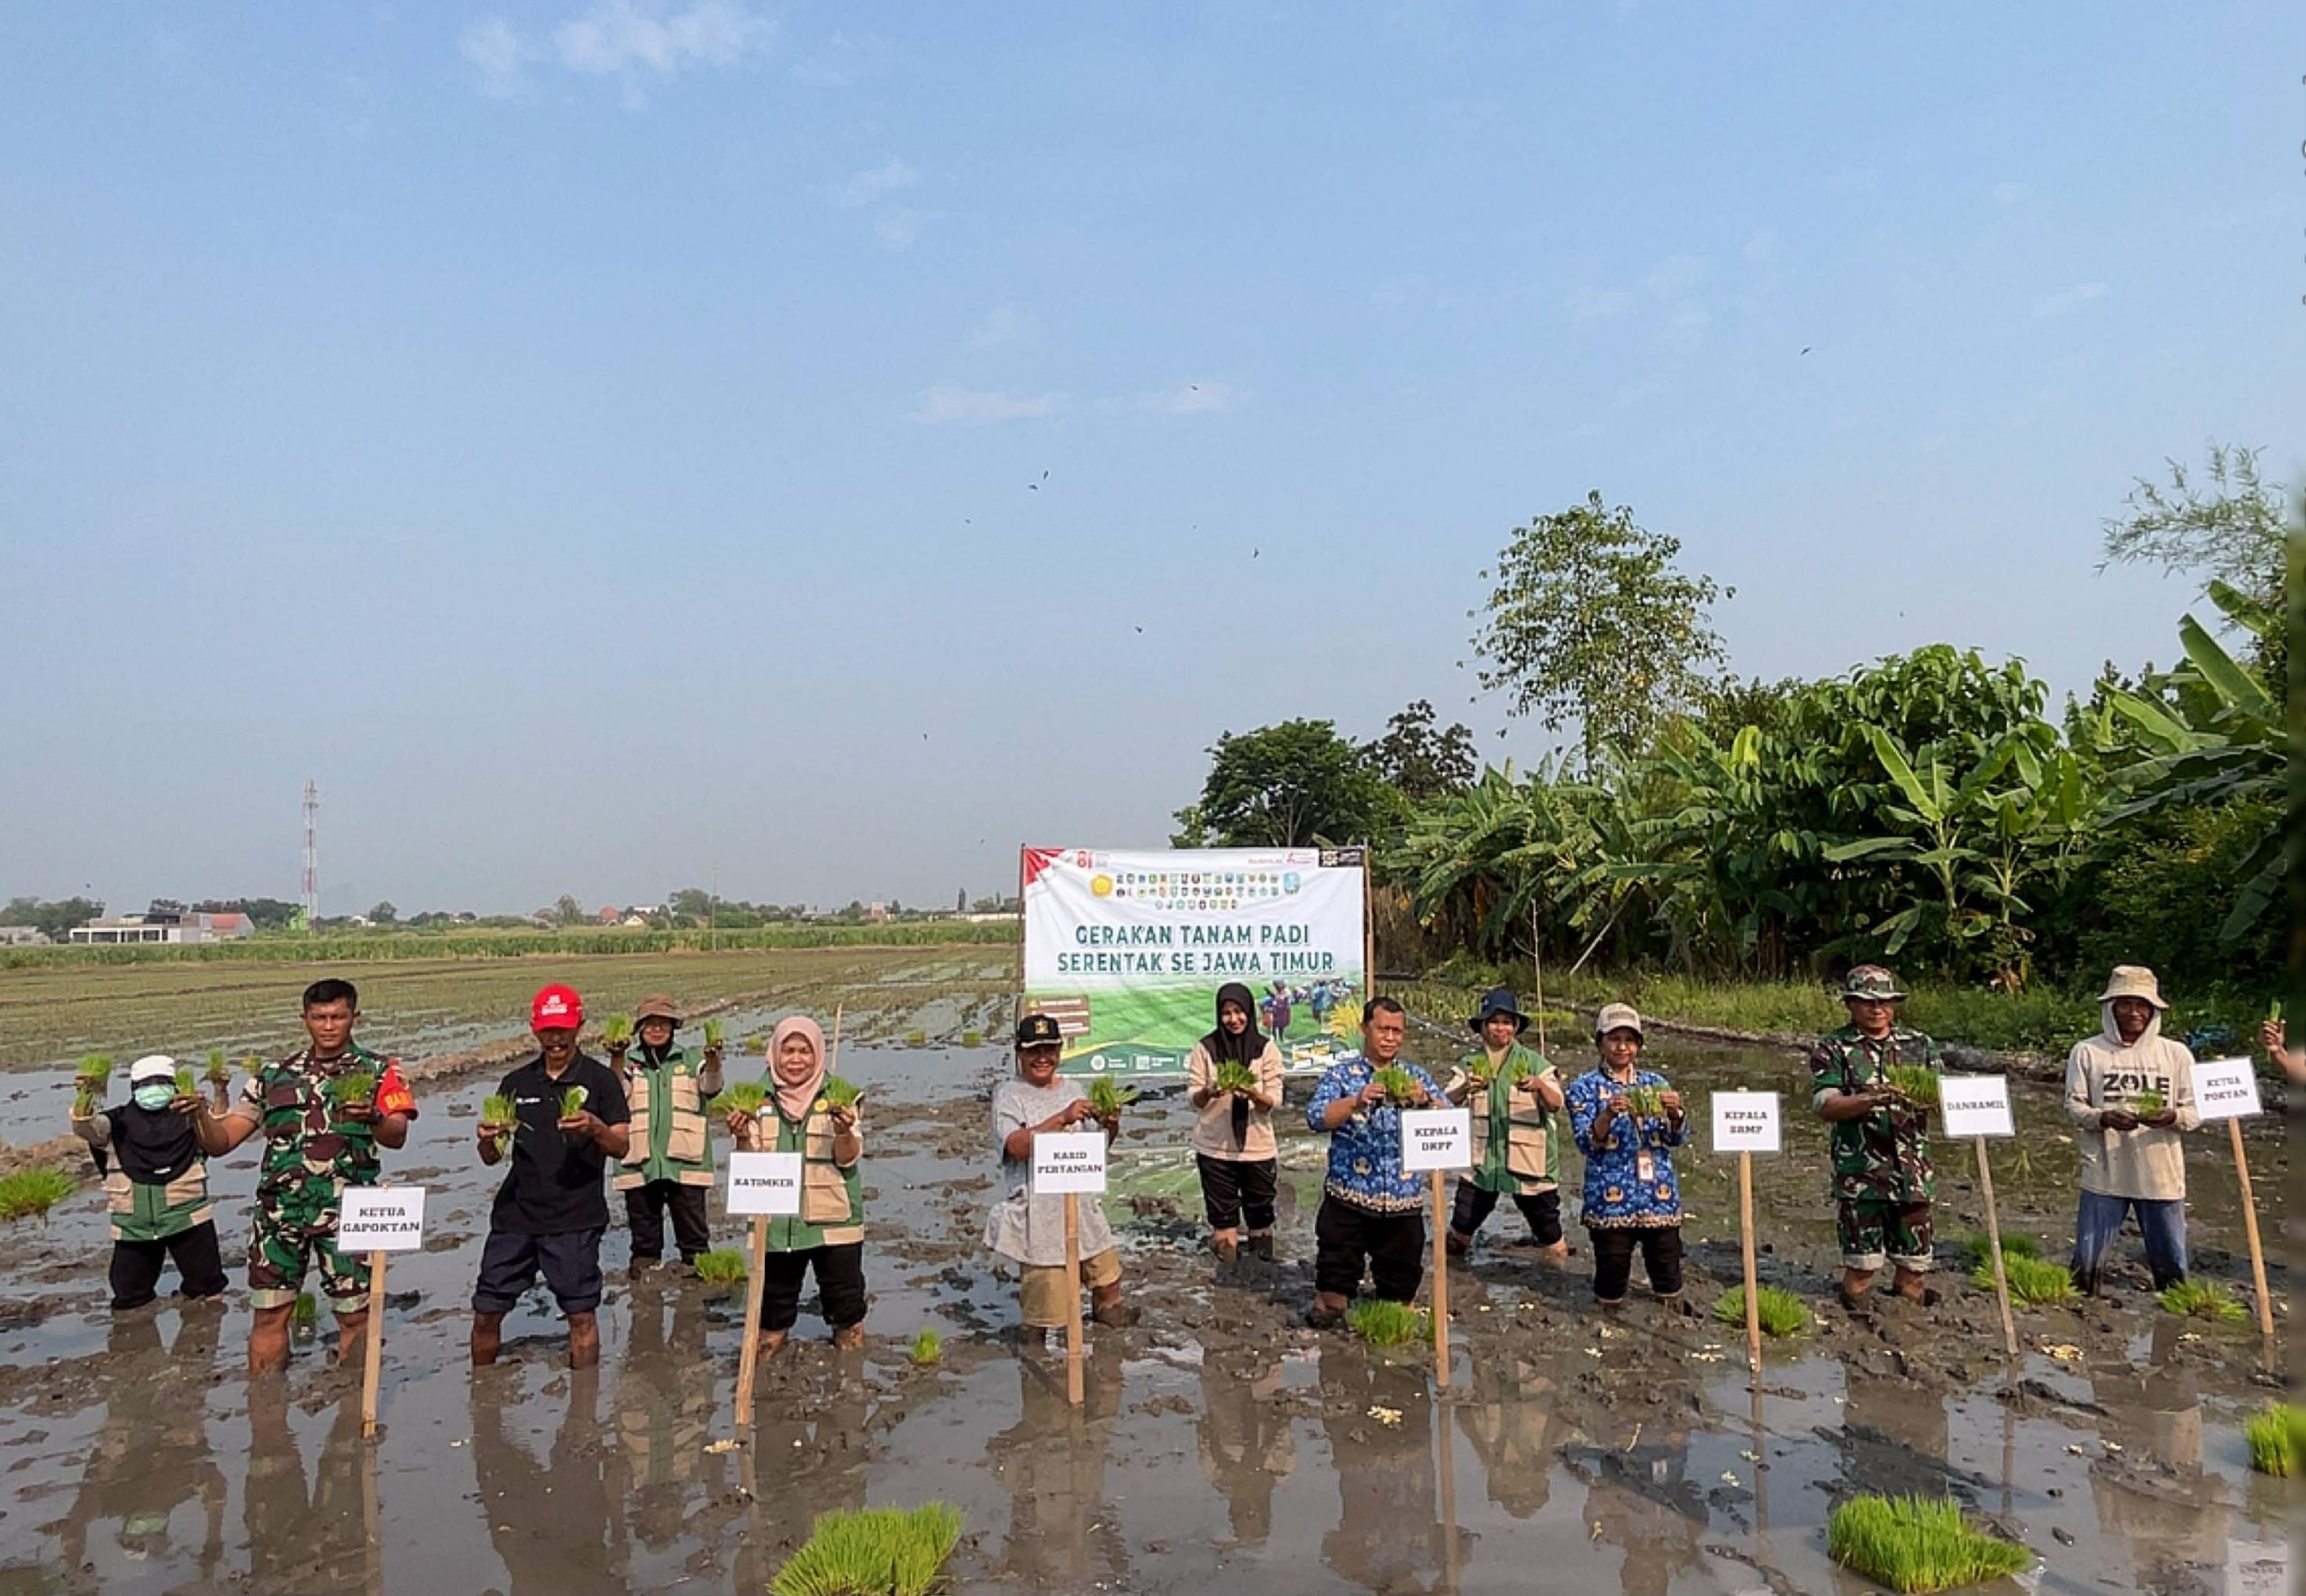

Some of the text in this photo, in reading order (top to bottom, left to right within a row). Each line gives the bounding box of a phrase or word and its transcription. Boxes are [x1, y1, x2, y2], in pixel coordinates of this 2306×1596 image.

[1076, 925, 1309, 944] GERAKAN TANAM PADI
[1058, 951, 1334, 972] SERENTAK SE JAWA TIMUR
[2206, 1075, 2241, 1087] KETUA
[2204, 1089, 2248, 1102] POKTAN
[1947, 1101, 2005, 1111] DANRAMIL
[1725, 1111, 1767, 1120] KEPALA
[1414, 1126, 1458, 1137] KEPALA
[1421, 1140, 1453, 1151] DKPP
[1038, 1164, 1102, 1174] PERTANIAN
[359, 1207, 405, 1217] KETUA
[343, 1221, 420, 1232] GAPOKTAN
